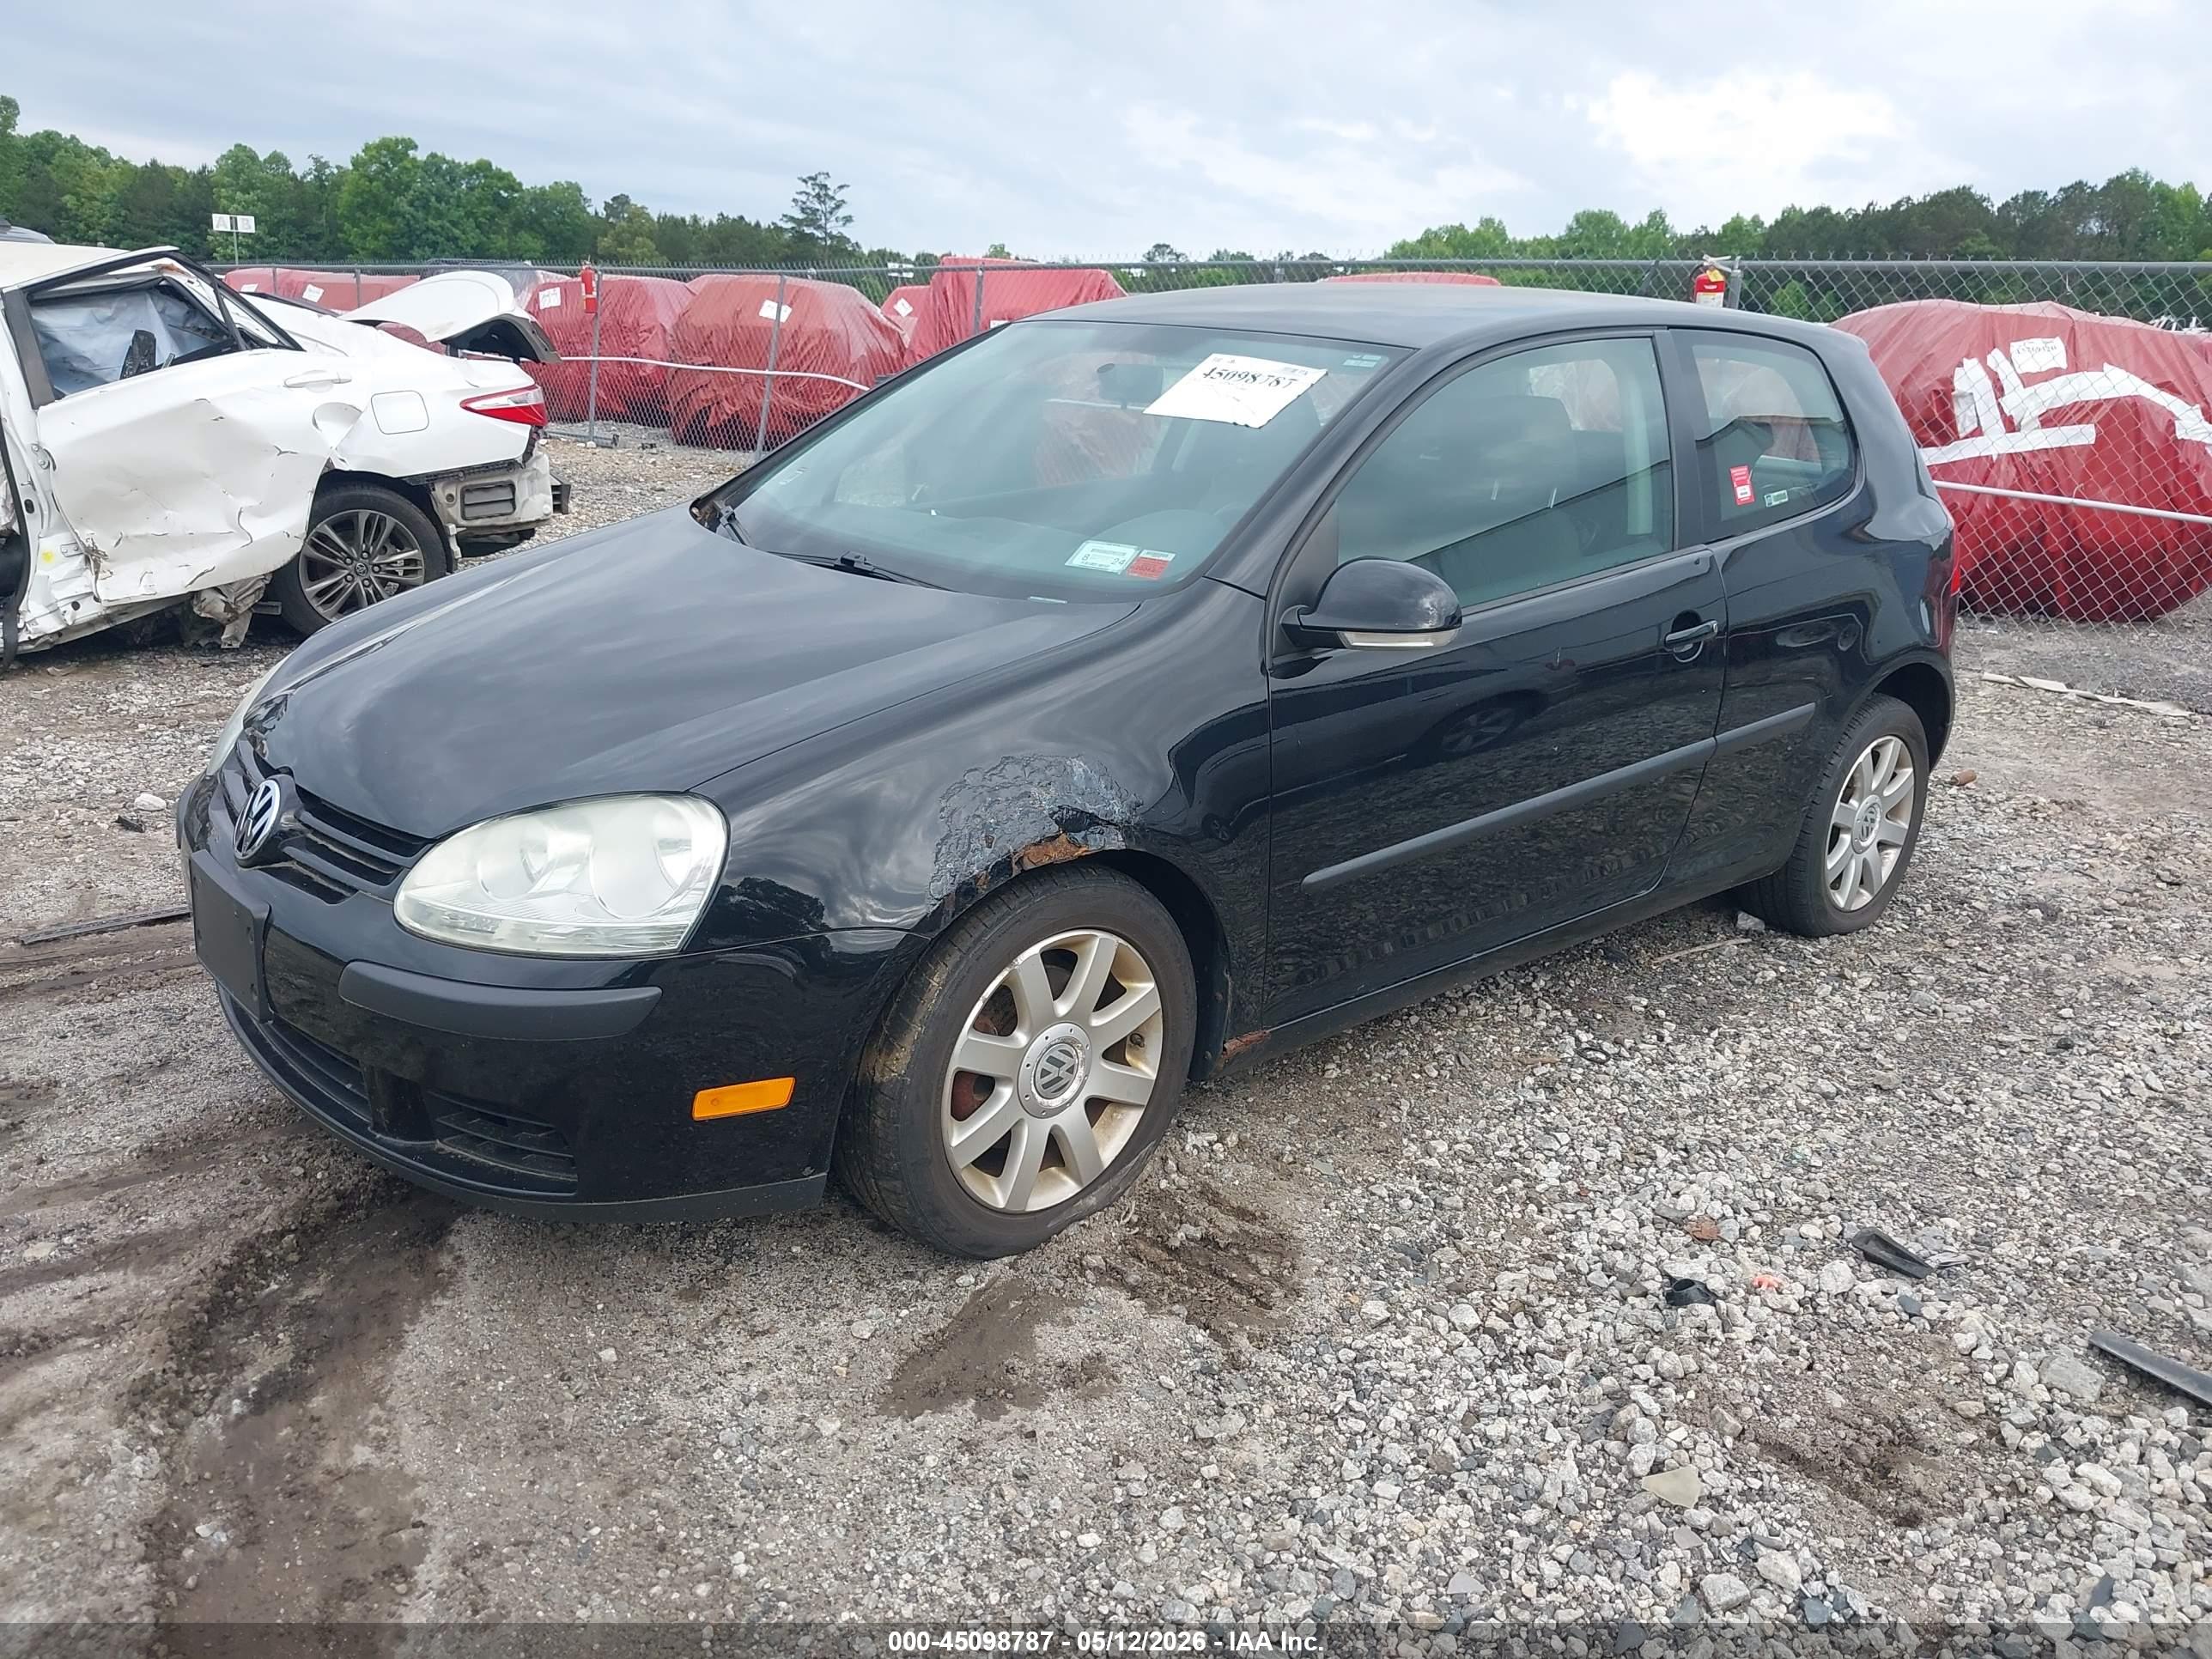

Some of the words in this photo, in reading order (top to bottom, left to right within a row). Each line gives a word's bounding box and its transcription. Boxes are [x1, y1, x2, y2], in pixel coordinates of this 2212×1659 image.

[215, 216, 228, 229] A
[240, 217, 252, 230] B
[1202, 367, 1298, 388] 45098787
